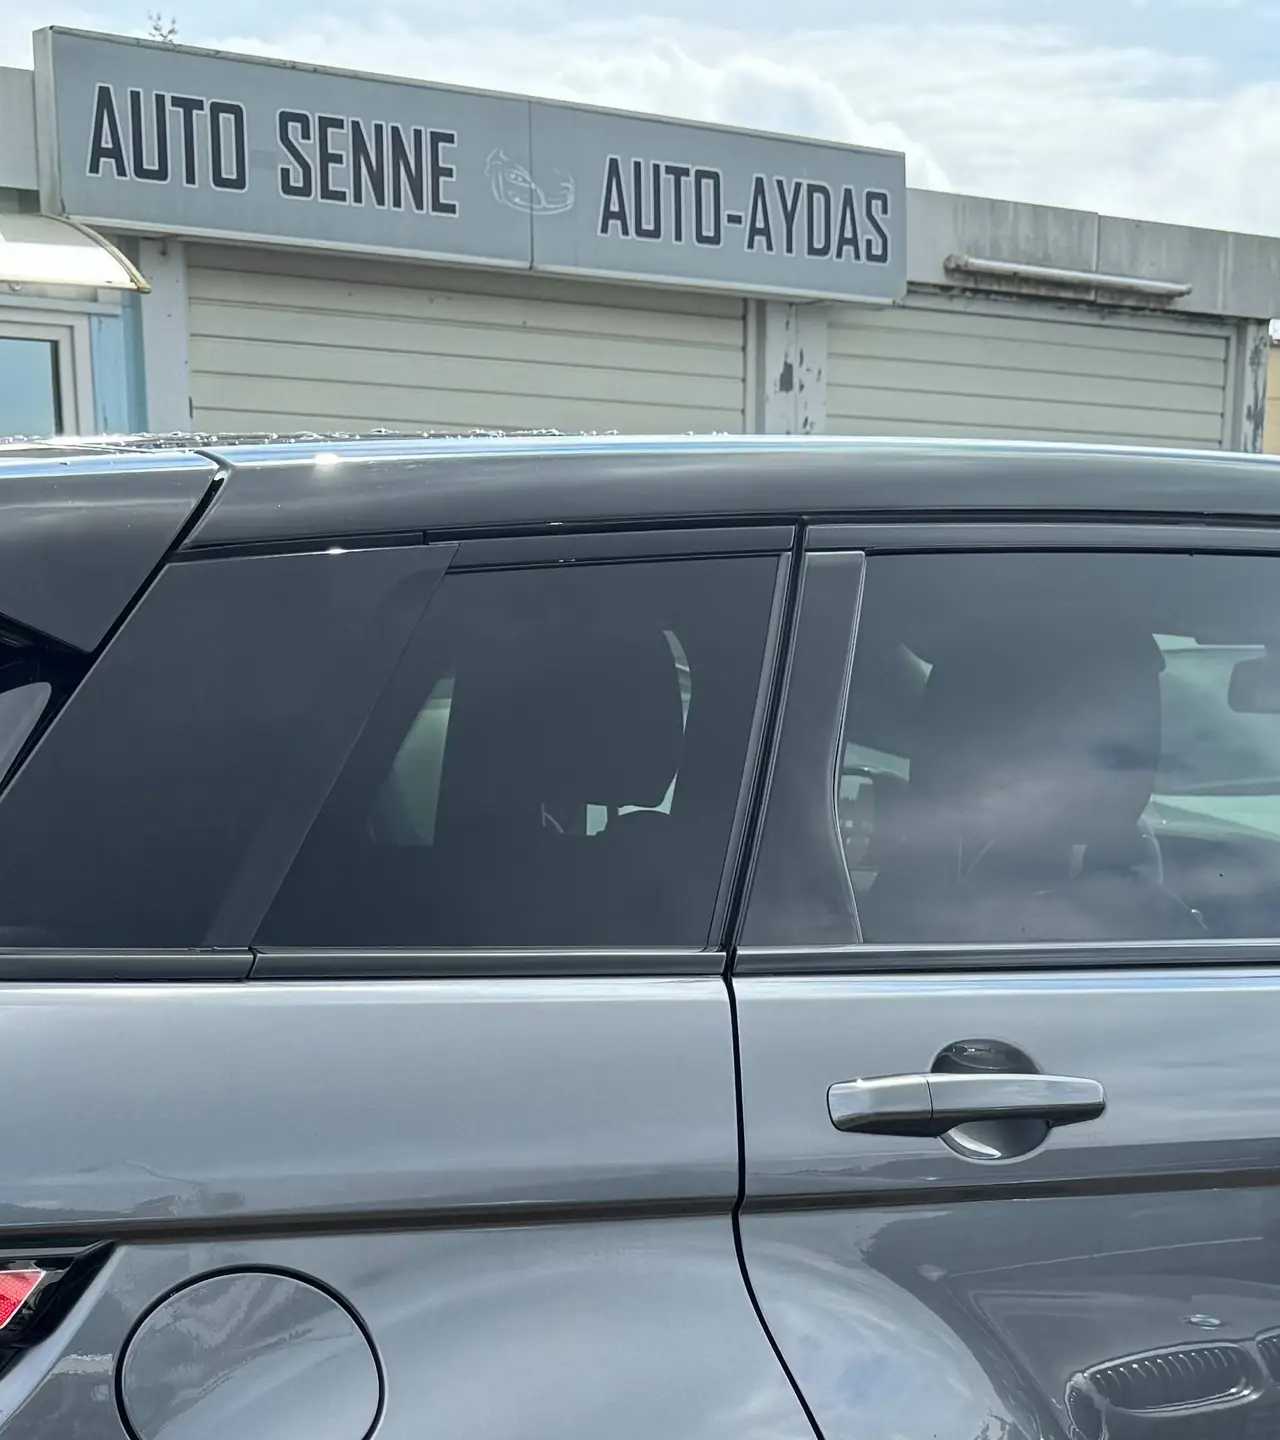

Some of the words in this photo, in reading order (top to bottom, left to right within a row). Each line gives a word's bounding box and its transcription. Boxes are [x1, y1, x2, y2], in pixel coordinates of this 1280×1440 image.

[87, 83, 249, 192] AUTO
[276, 107, 458, 217] SENNE
[597, 154, 890, 266] AUTO-AYDAS
